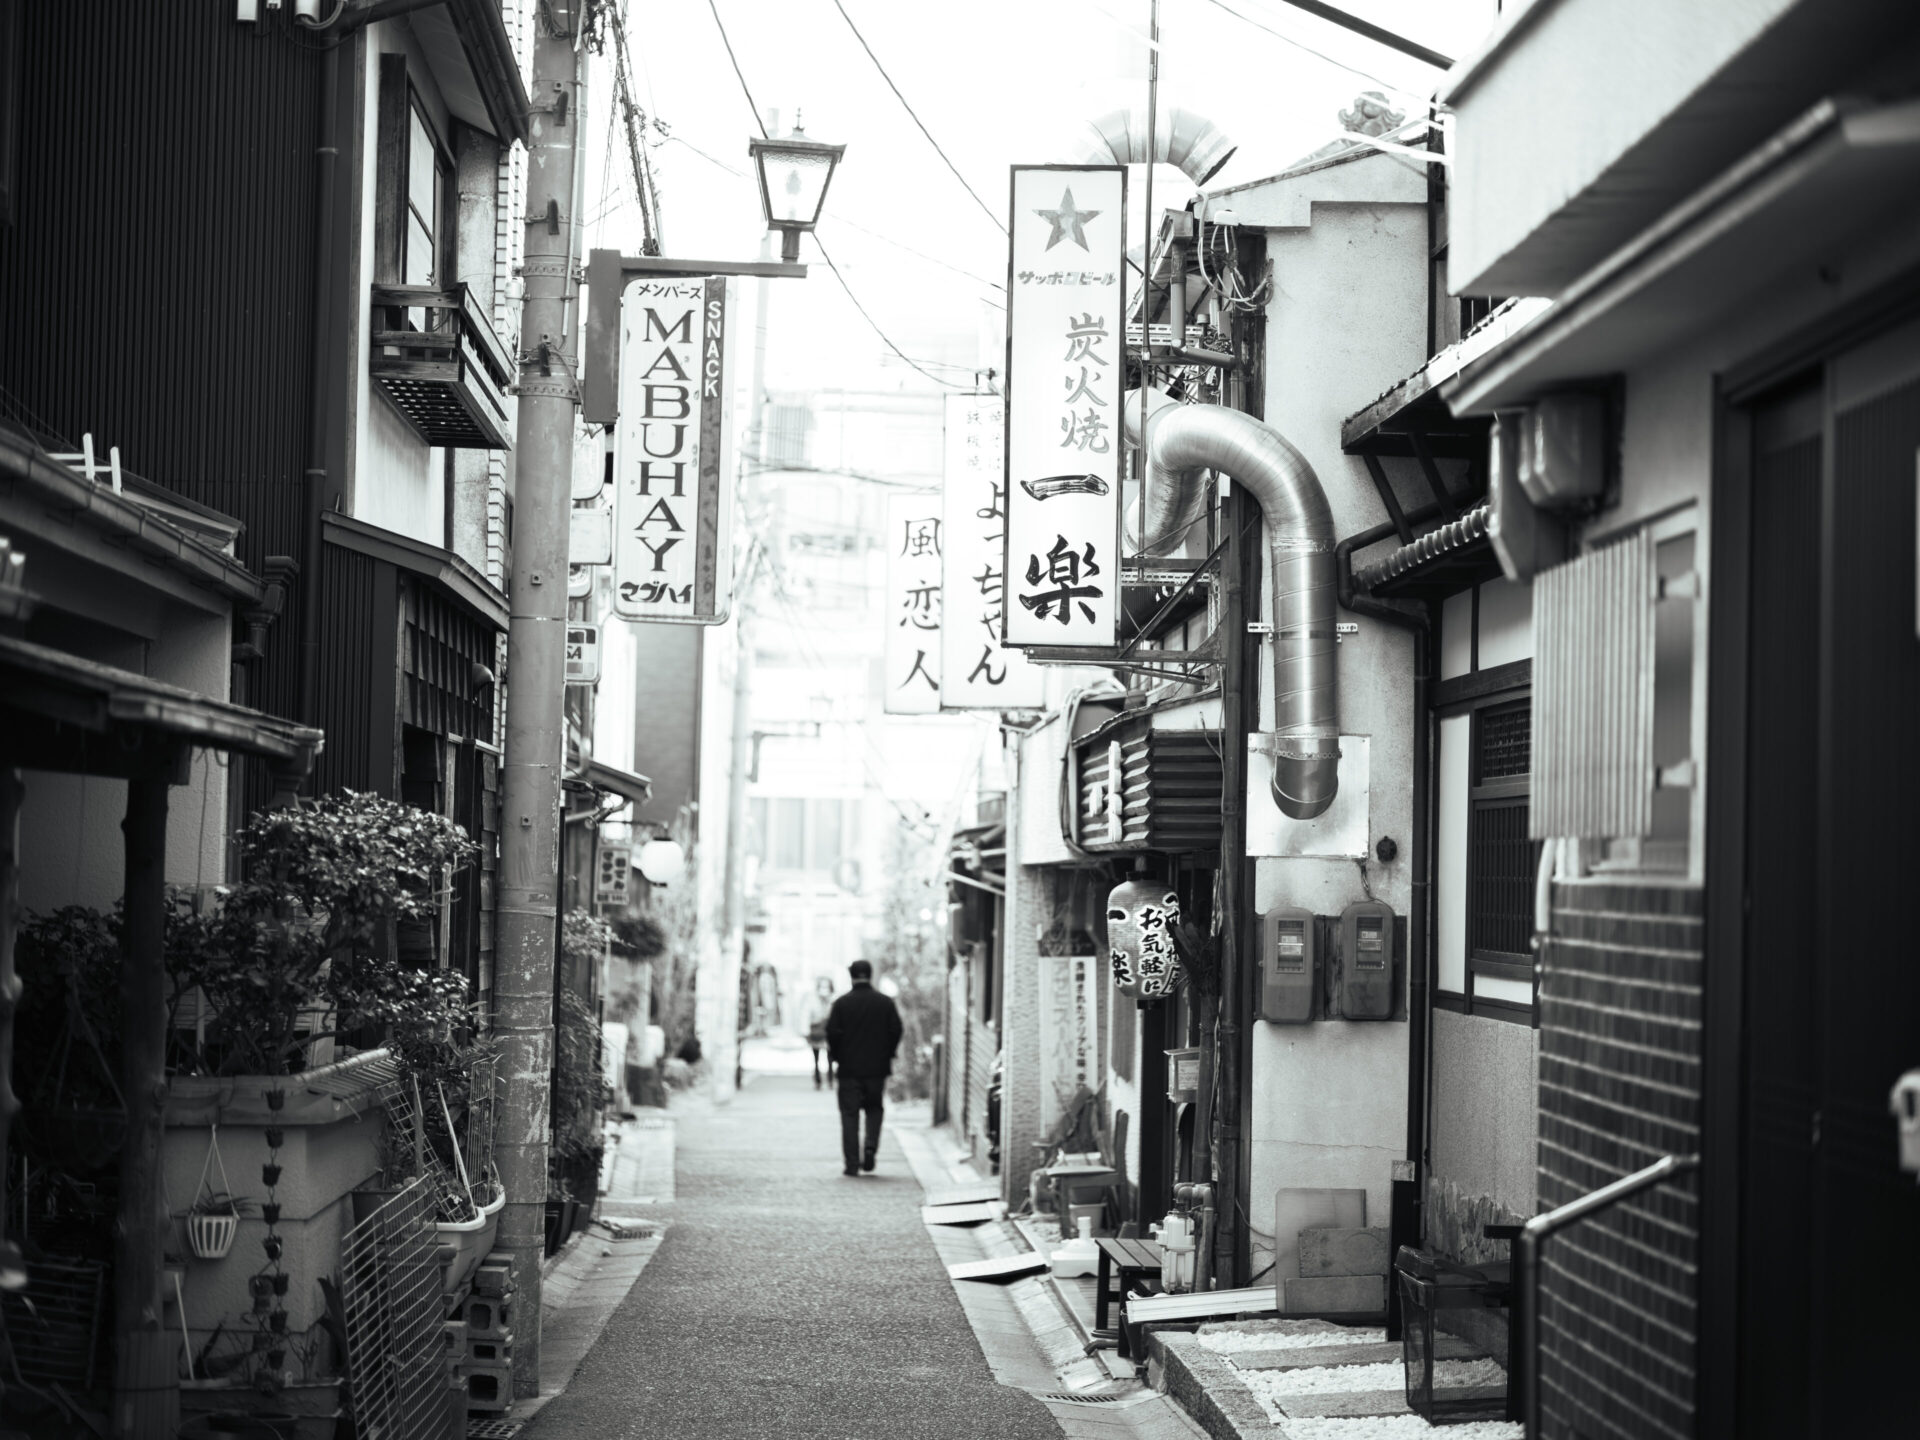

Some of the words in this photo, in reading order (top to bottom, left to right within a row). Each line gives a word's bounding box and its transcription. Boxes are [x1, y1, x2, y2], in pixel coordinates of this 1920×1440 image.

[637, 283, 702, 300] メンバーズ
[1017, 270, 1117, 286] サッポロビール
[704, 301, 722, 399] SNACK
[1060, 312, 1110, 454] 炭火焼
[633, 307, 697, 573] MABUHAY
[618, 579, 694, 605] マブハイ
[1018, 473, 1110, 625] 一楽
[899, 517, 941, 691] 風恋人
[1139, 907, 1164, 993] お気軽に
